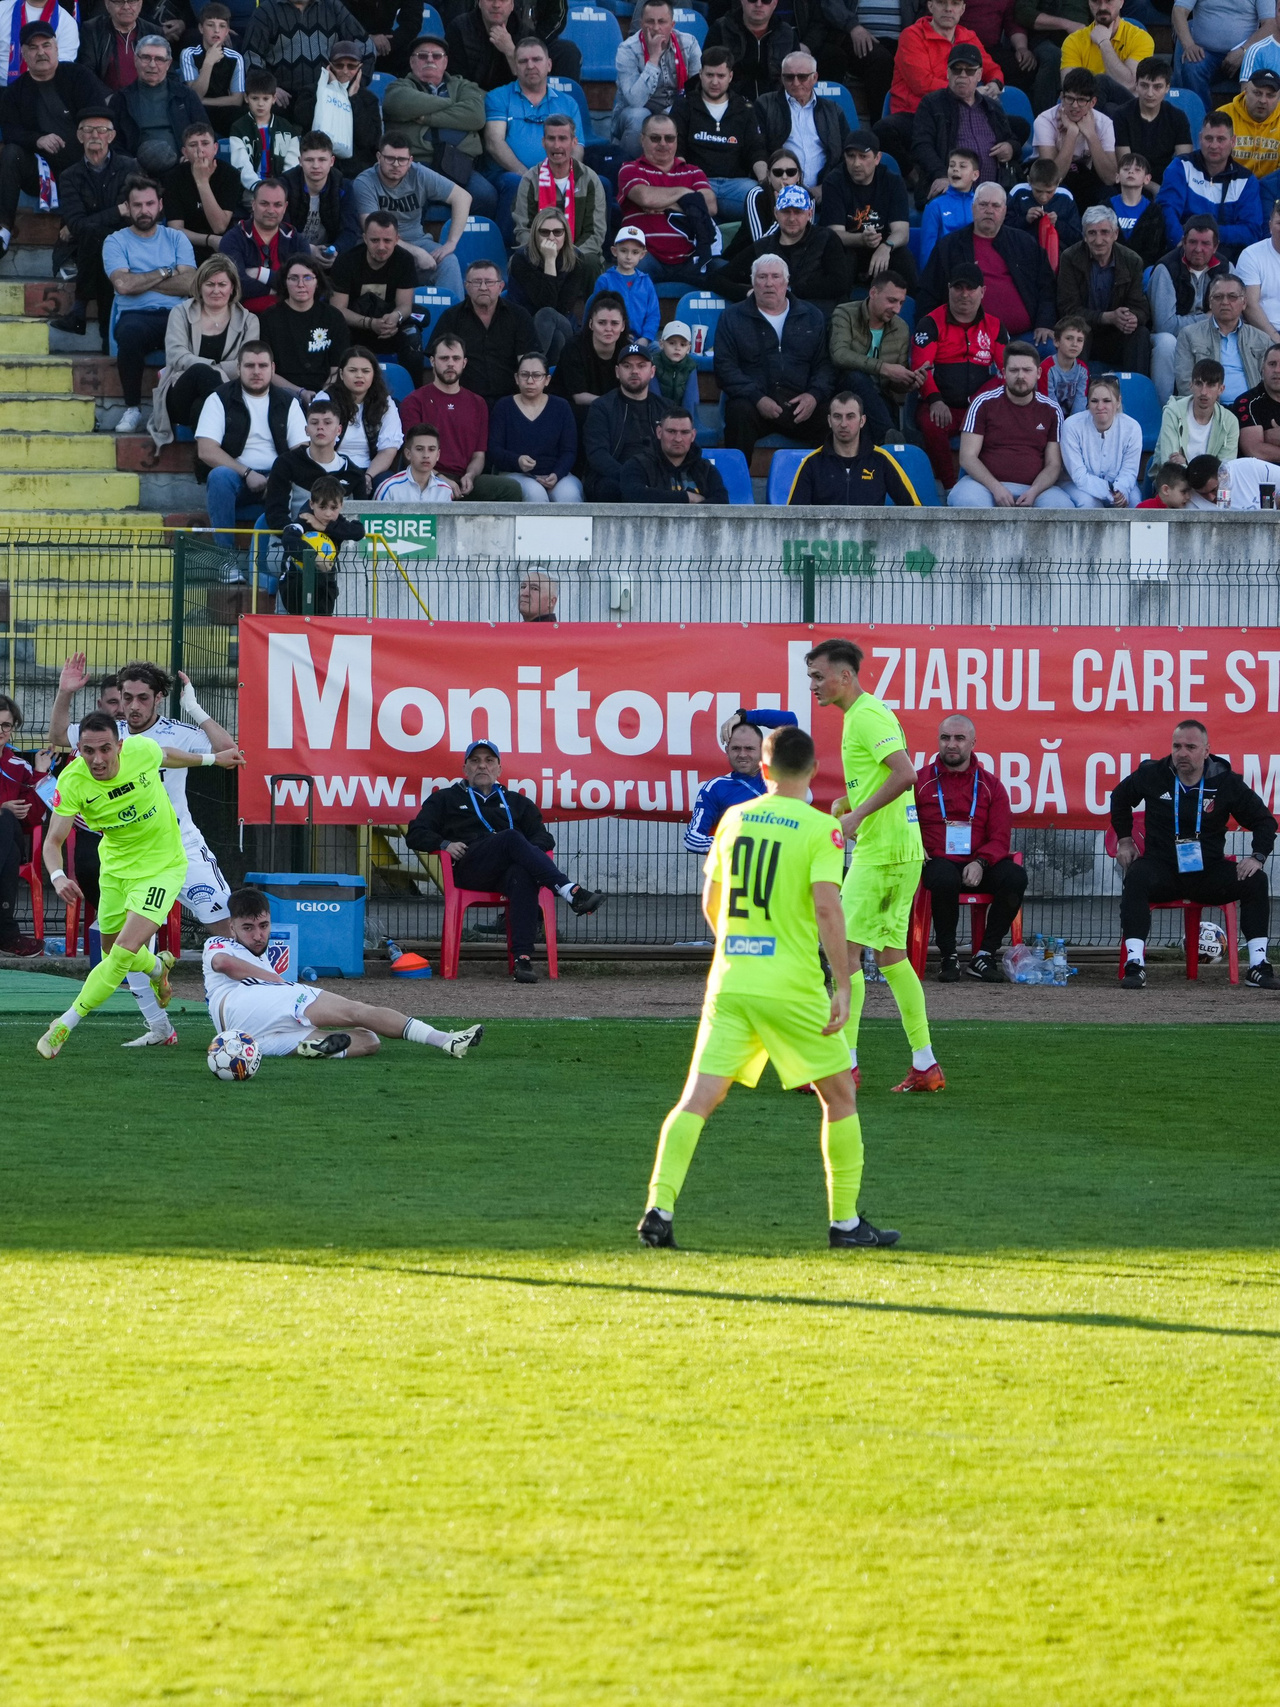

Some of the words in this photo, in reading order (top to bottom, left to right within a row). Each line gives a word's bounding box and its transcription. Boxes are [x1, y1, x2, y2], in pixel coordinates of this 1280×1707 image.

[693, 131, 727, 144] ellesse
[871, 647, 1055, 711] ZIARUL
[1072, 649, 1208, 713] CARE
[141, 806, 159, 820] BET
[728, 835, 781, 921] 24
[144, 886, 167, 910] 30
[296, 902, 341, 912] IGLOO
[1198, 943, 1219, 954] ELECT
